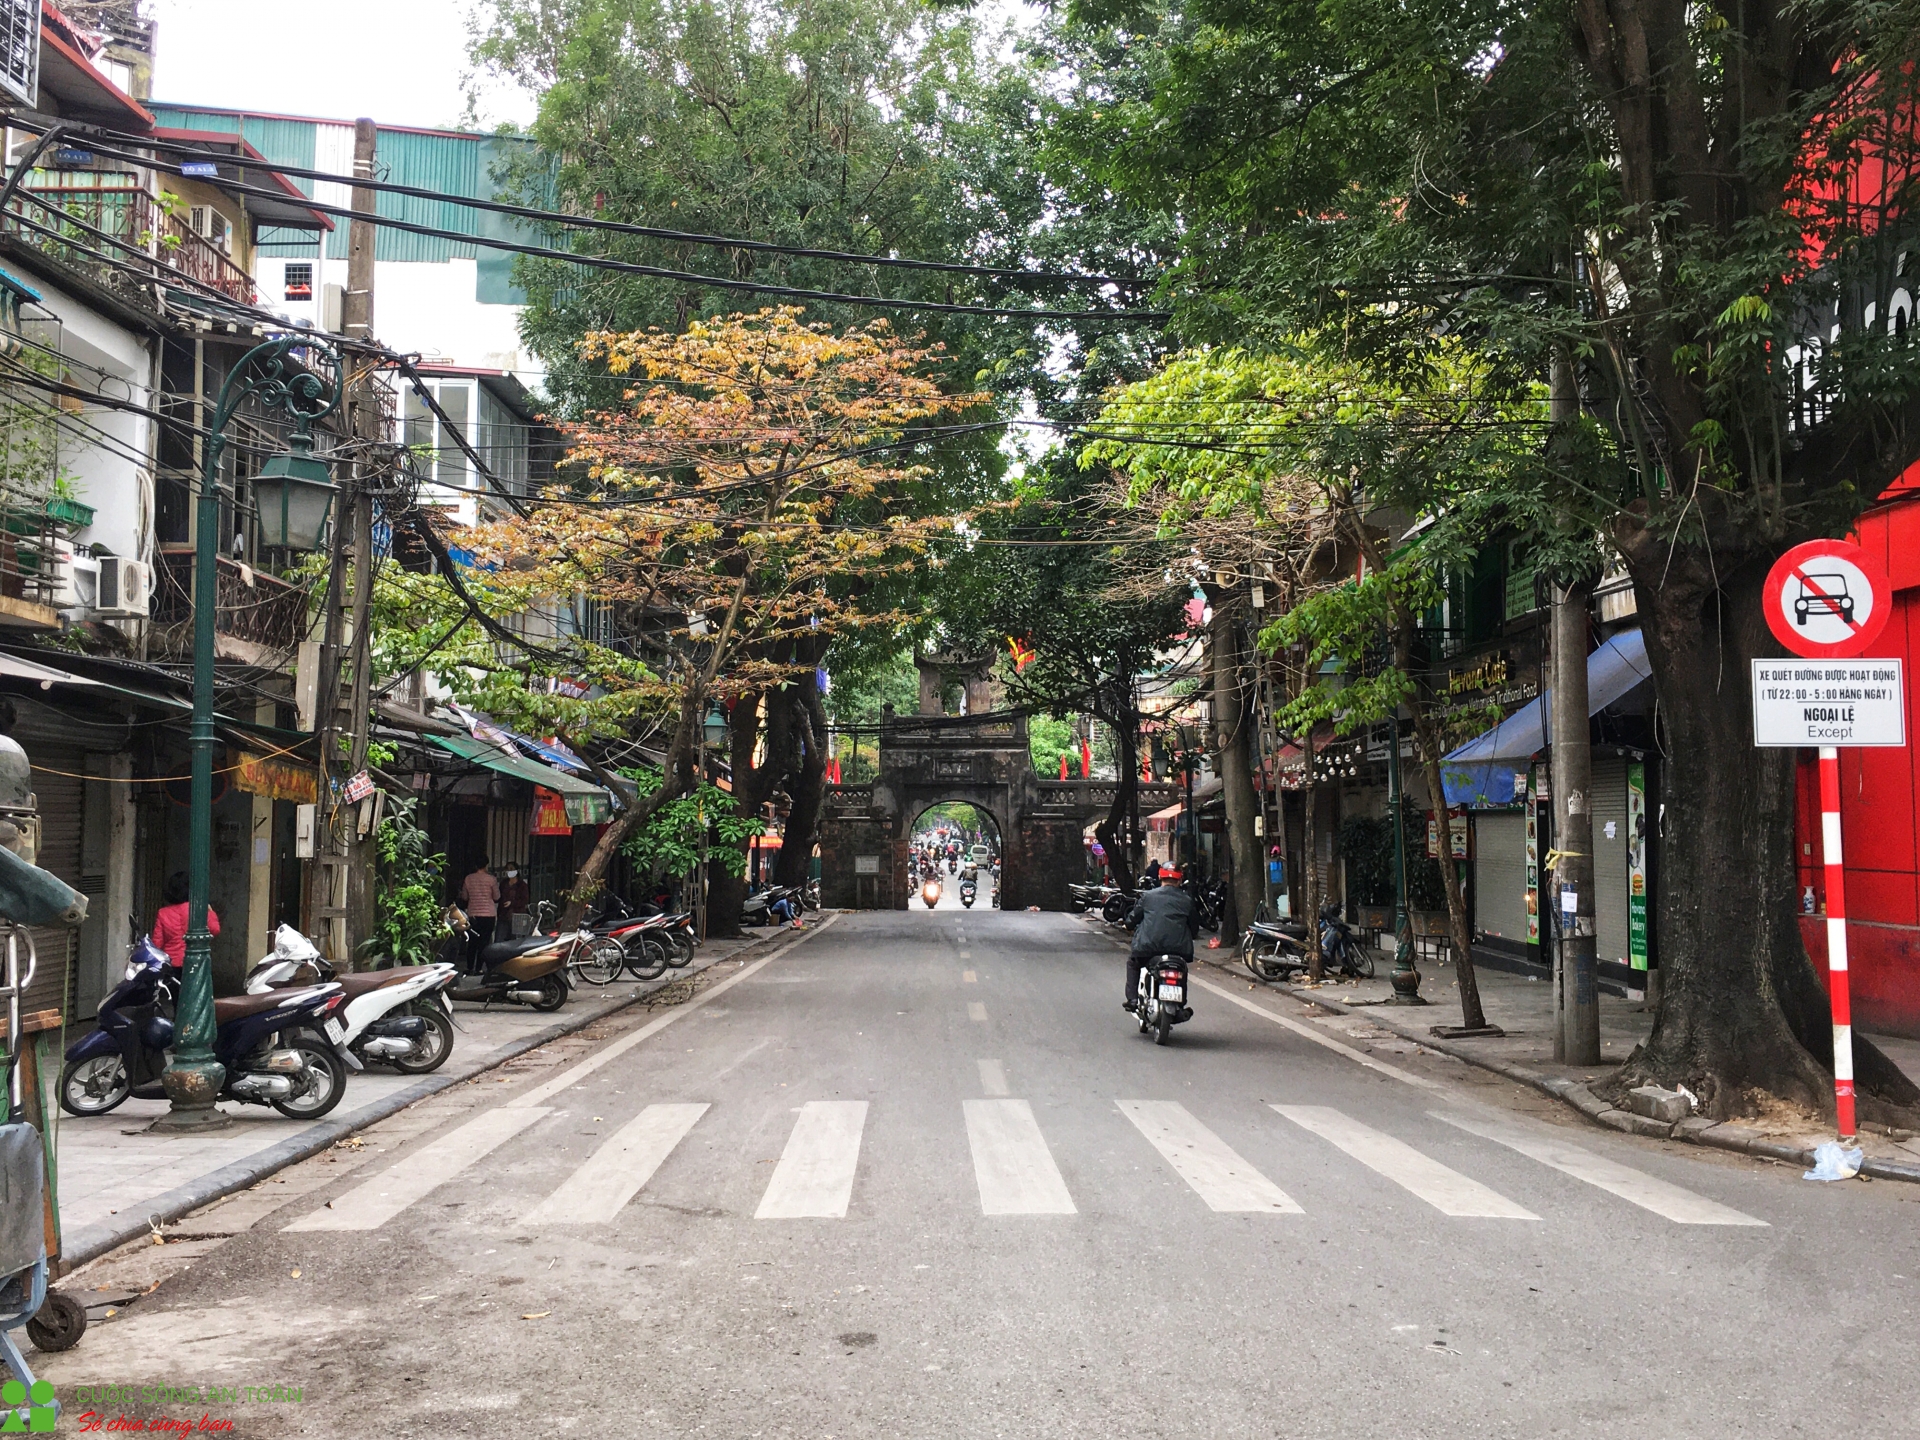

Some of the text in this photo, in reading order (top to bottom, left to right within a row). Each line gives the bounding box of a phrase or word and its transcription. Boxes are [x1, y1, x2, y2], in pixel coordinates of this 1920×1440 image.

[1759, 667, 1896, 683] XE QUÉT ĐƯỜNG ĐƯỢC HOẠT ĐỘNG
[1522, 680, 1538, 700] Food
[1839, 686, 1862, 700] HÀNG
[1803, 705, 1855, 724] NGOẠI LỆ
[1808, 725, 1853, 740] Except
